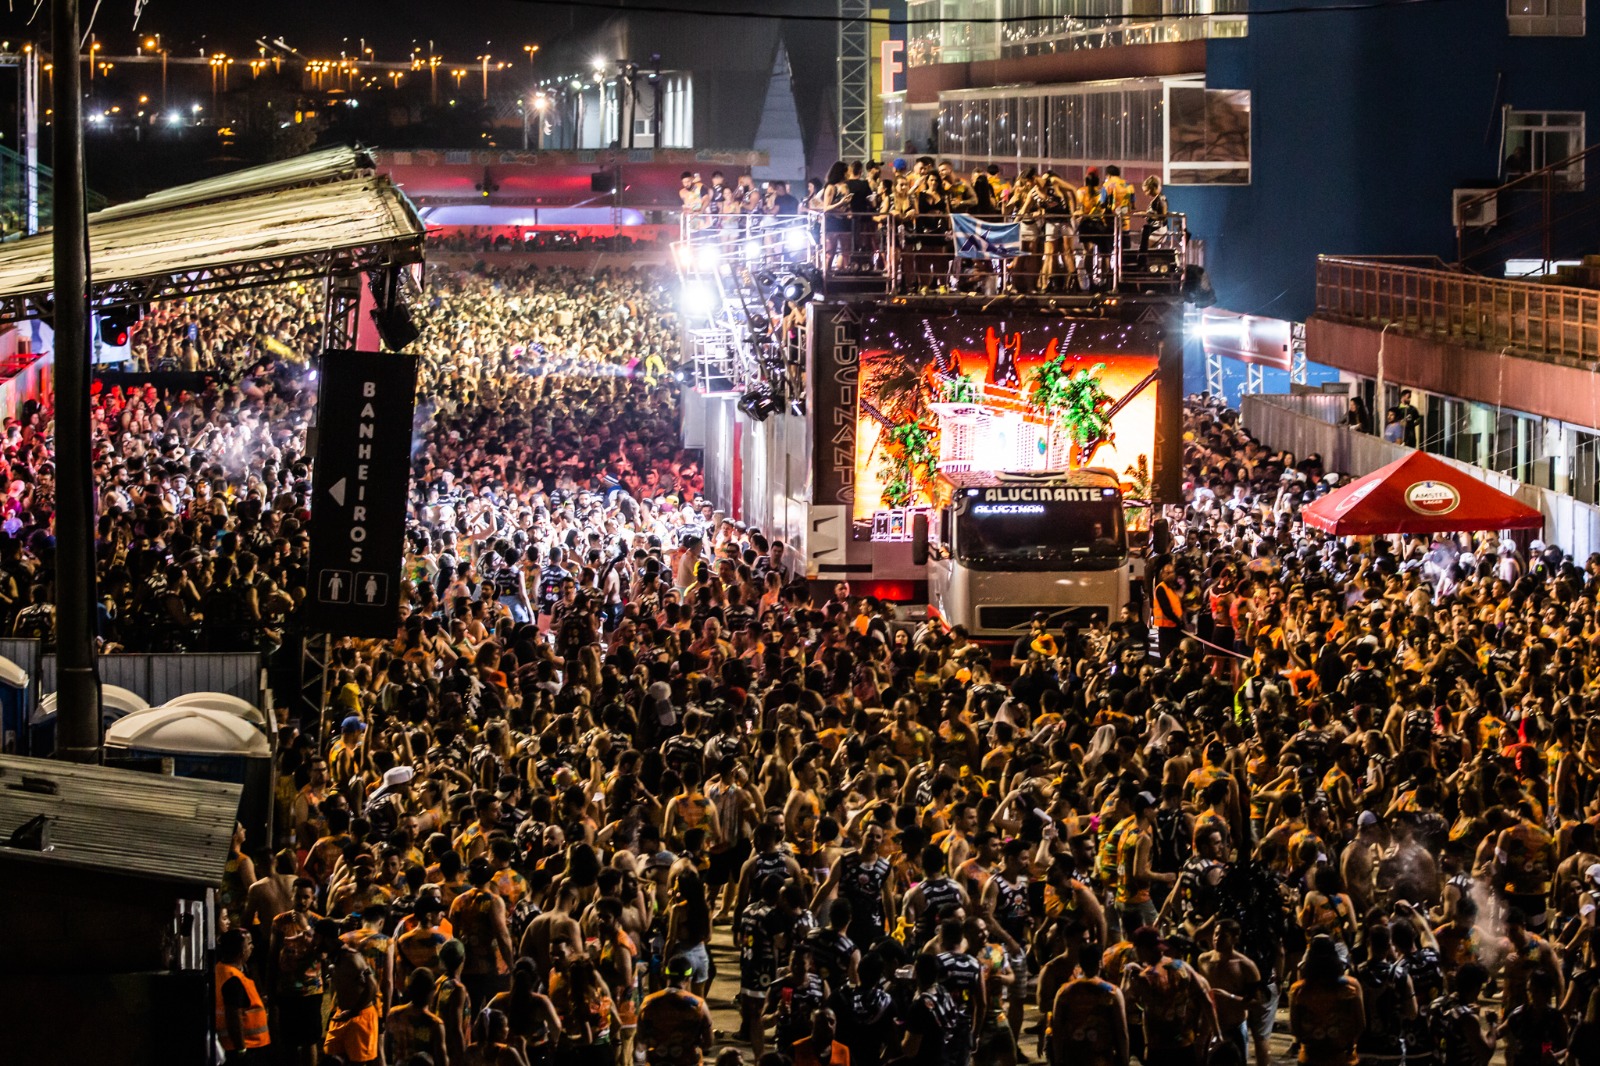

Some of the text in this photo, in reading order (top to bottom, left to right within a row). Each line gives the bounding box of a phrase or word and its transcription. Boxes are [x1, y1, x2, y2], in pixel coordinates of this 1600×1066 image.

[881, 40, 904, 94] F
[350, 381, 376, 563] BANHEIROS
[974, 505, 1045, 514] ALUCINAN
[985, 488, 1103, 502] ALUCINANTE
